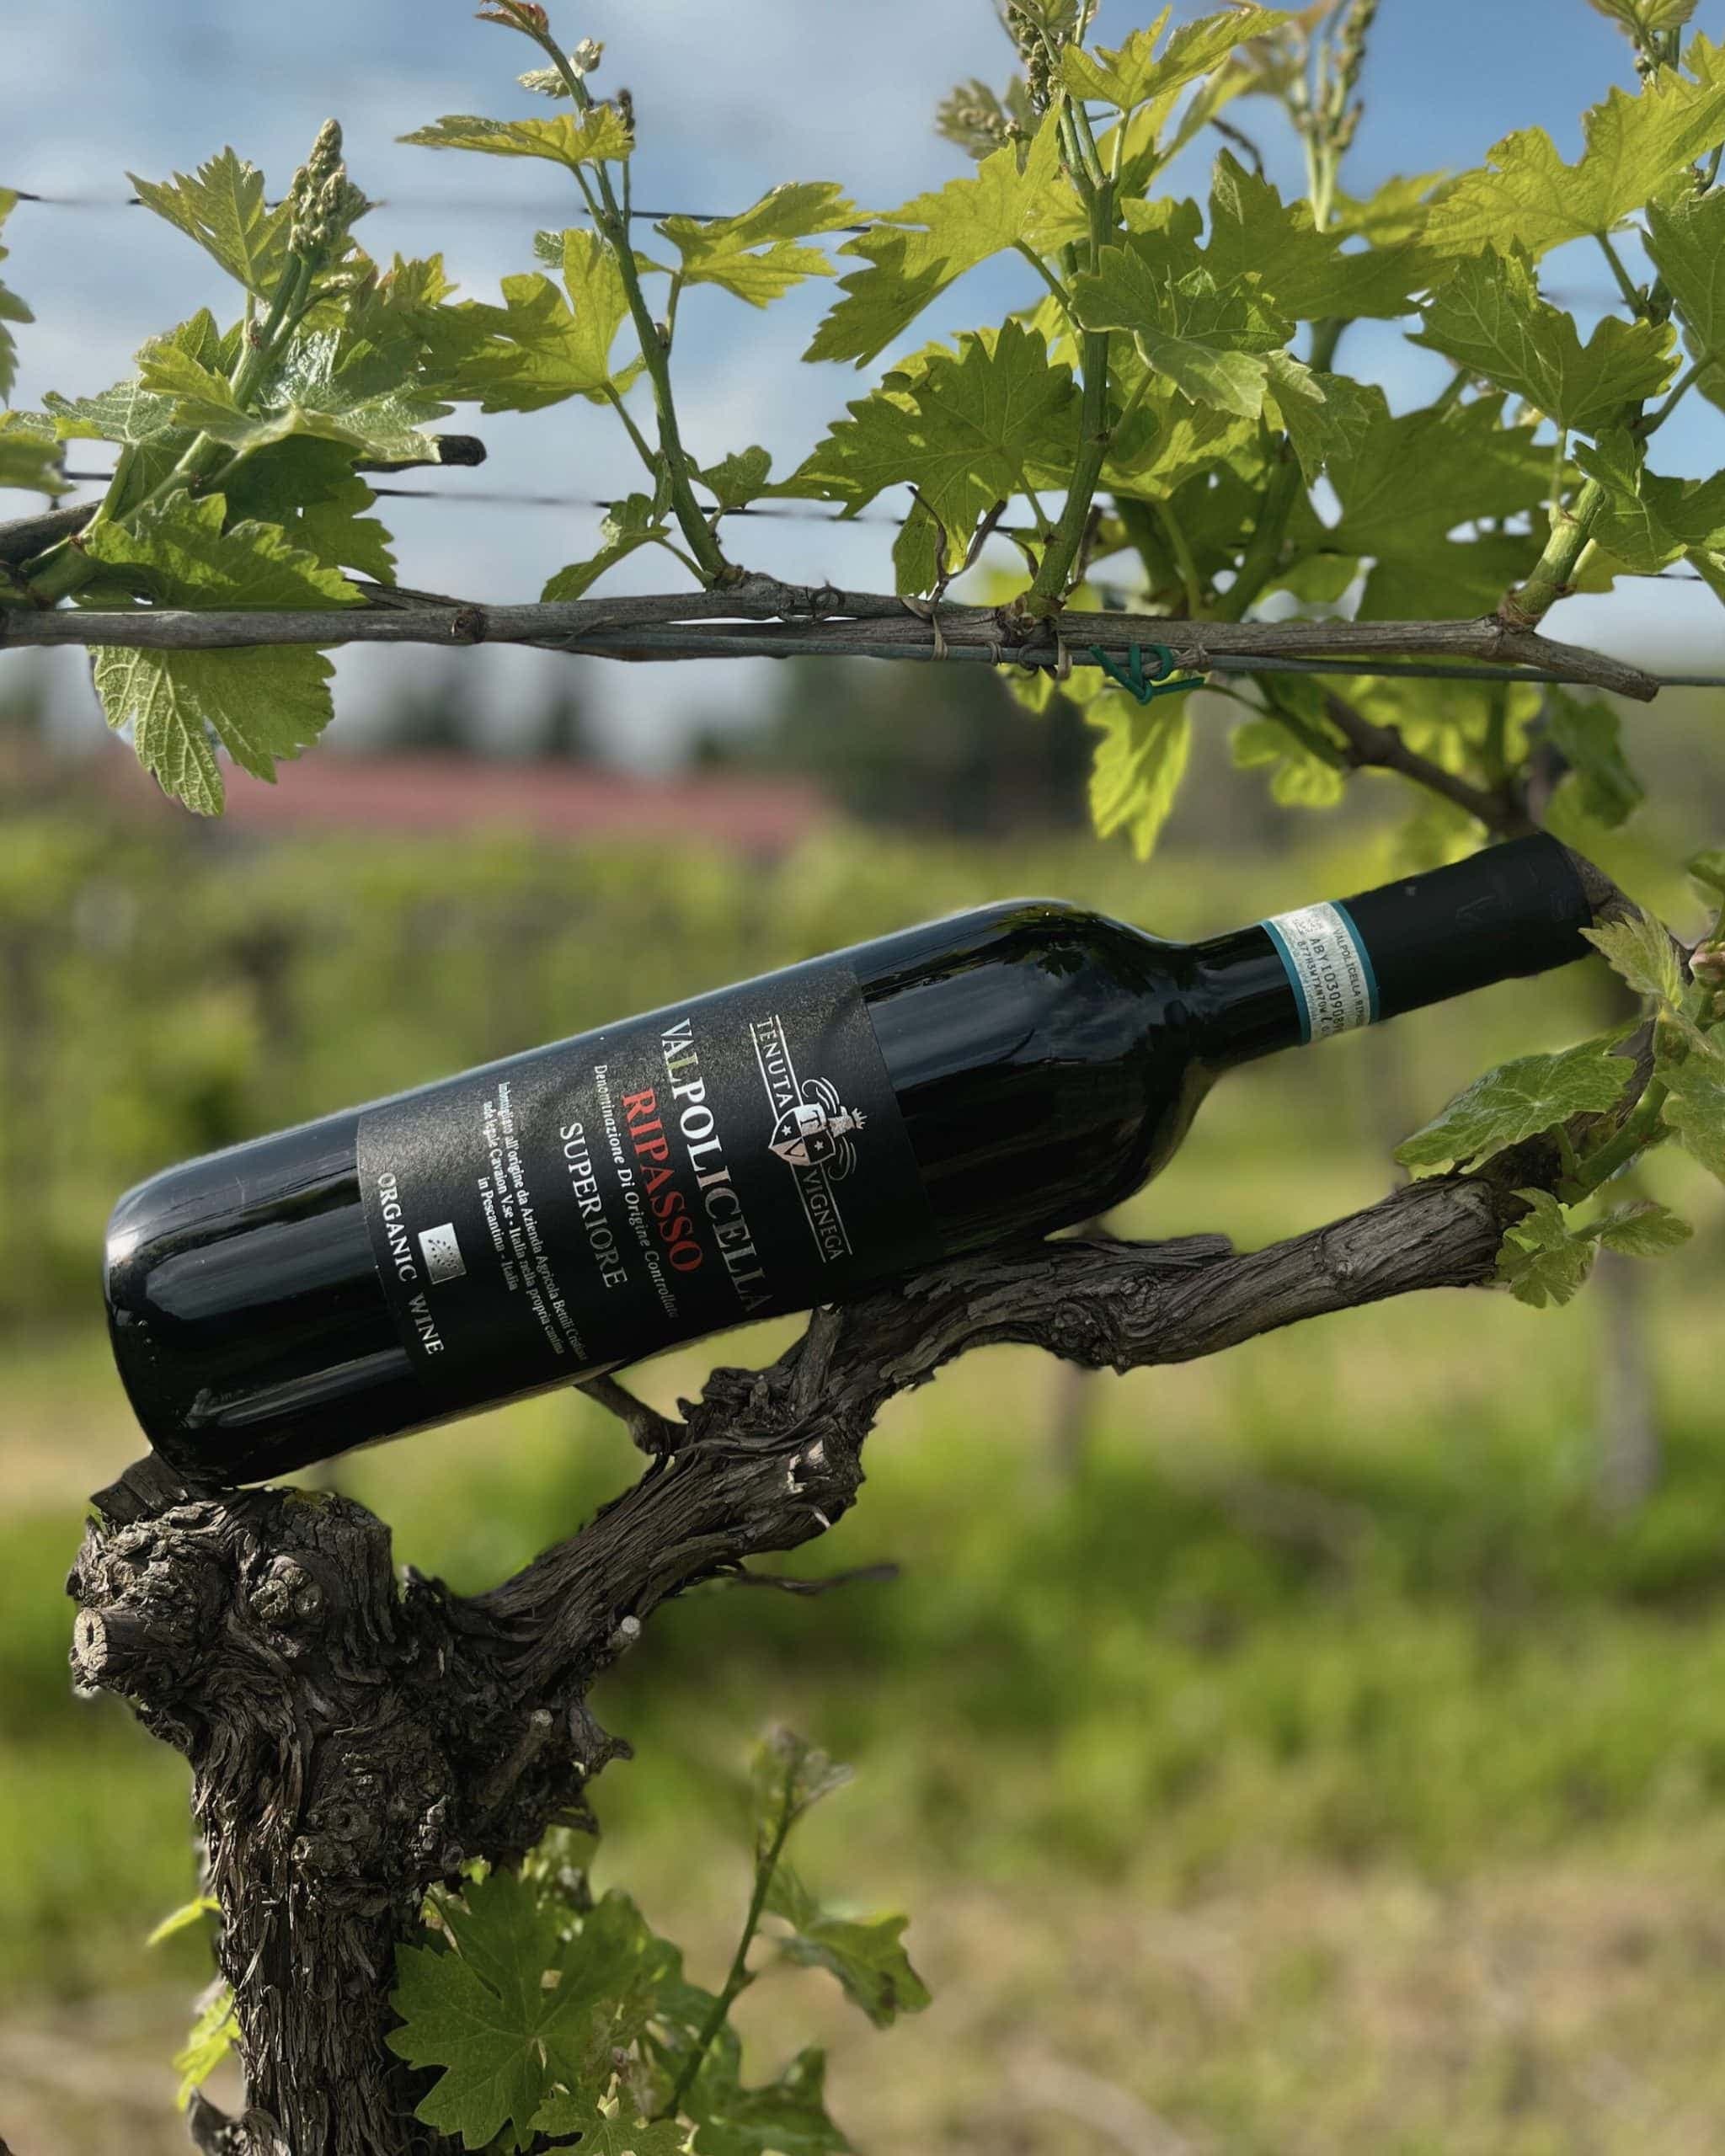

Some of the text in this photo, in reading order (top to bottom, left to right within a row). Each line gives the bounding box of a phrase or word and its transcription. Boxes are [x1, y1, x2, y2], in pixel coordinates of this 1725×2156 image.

[1332, 929, 1361, 997] VALPOLICELLA
[755, 1017, 842, 1261] TENUTA VIGNEGA
[798, 1108, 822, 1126] T
[659, 1017, 774, 1314] VALPOLICELLA
[784, 1139, 806, 1156] V
[478, 1176, 489, 1190] in
[489, 1148, 507, 1194] Cavaion
[593, 1063, 679, 1321] Denominazione Di Origine Controllata
[621, 1086, 704, 1273] RIPASSO
[500, 1194, 515, 1219] V.se
[516, 1187, 530, 1205] da
[558, 1120, 628, 1289] SUPERIORE
[481, 1189, 507, 1251] Pescantina
[510, 1226, 528, 1259] Italia
[521, 1206, 543, 1254] Azienda
[375, 1171, 445, 1356] ORGANIC WINE
[501, 1260, 520, 1291] Italia
[519, 1258, 537, 1287] nella
[537, 1253, 559, 1299] Agricola
[526, 1288, 553, 1325] propria
